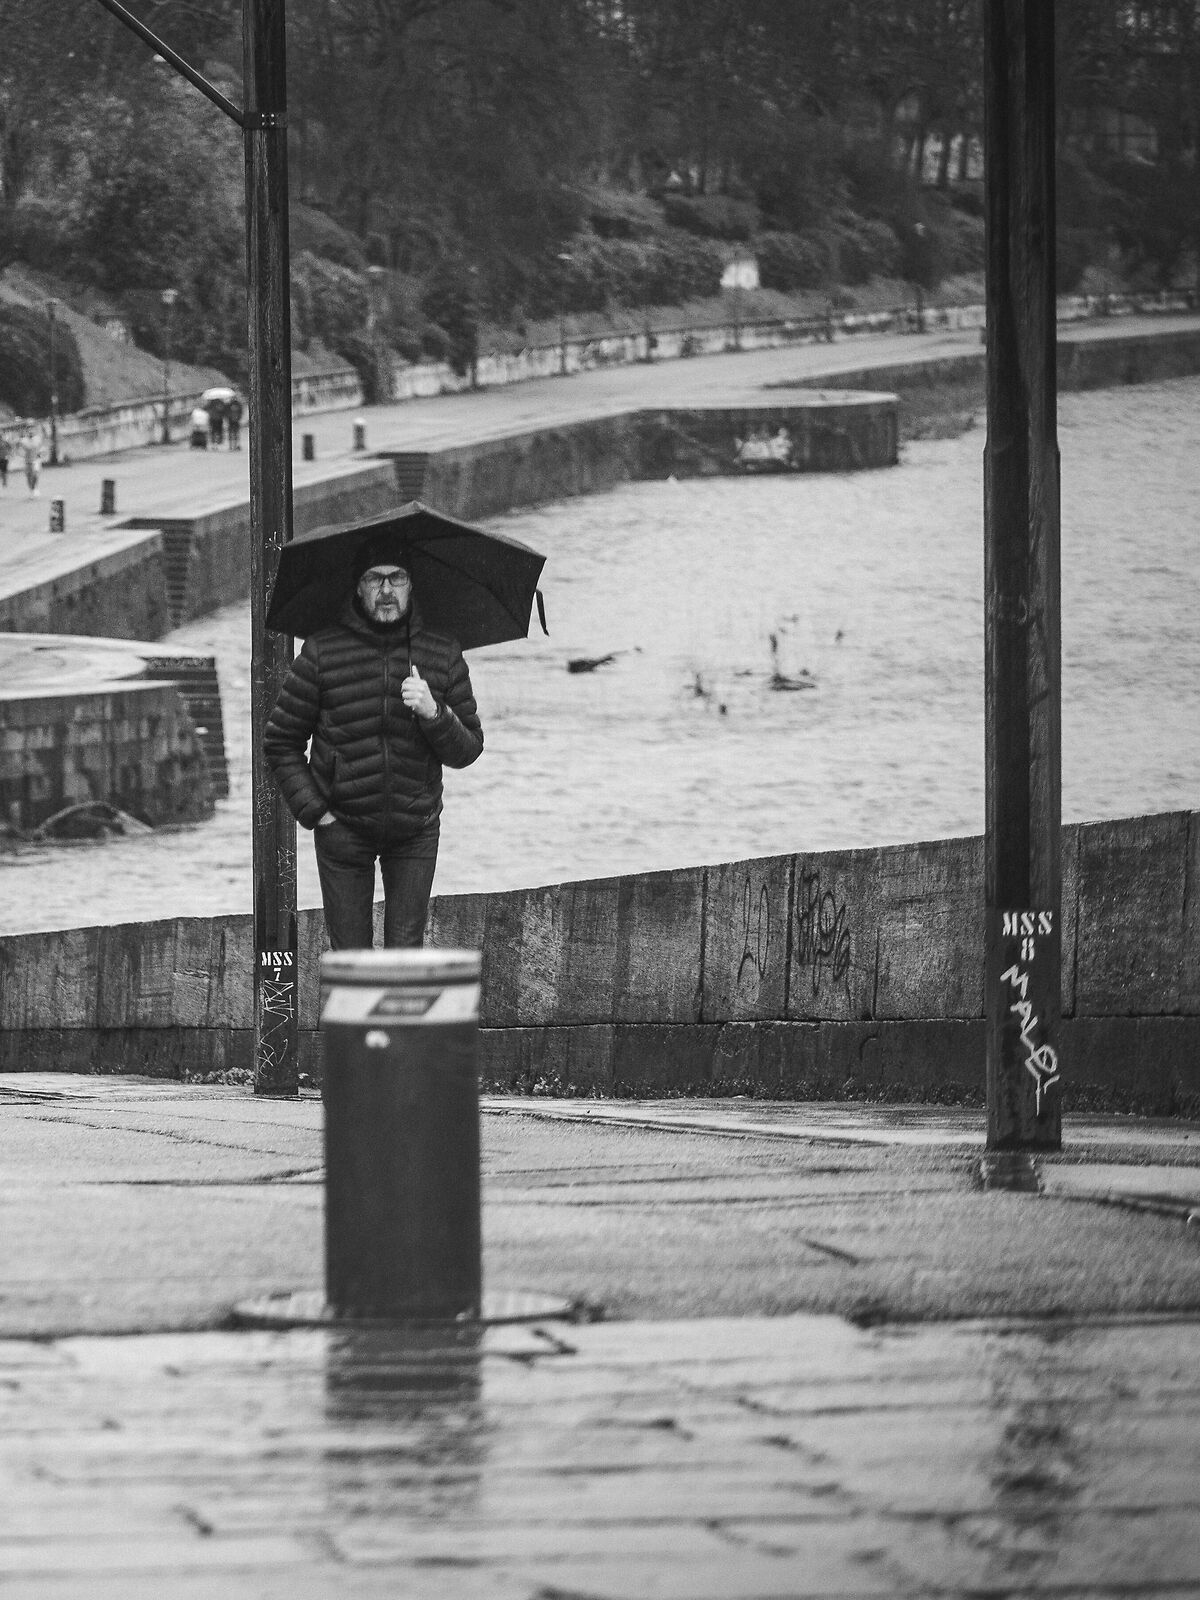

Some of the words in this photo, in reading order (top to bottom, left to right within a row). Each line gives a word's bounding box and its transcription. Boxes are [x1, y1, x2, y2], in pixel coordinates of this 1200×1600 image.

[1002, 911, 1053, 936] MSS
[261, 951, 293, 966] MSS
[1021, 937, 1035, 961] 8
[273, 967, 282, 982] 7
